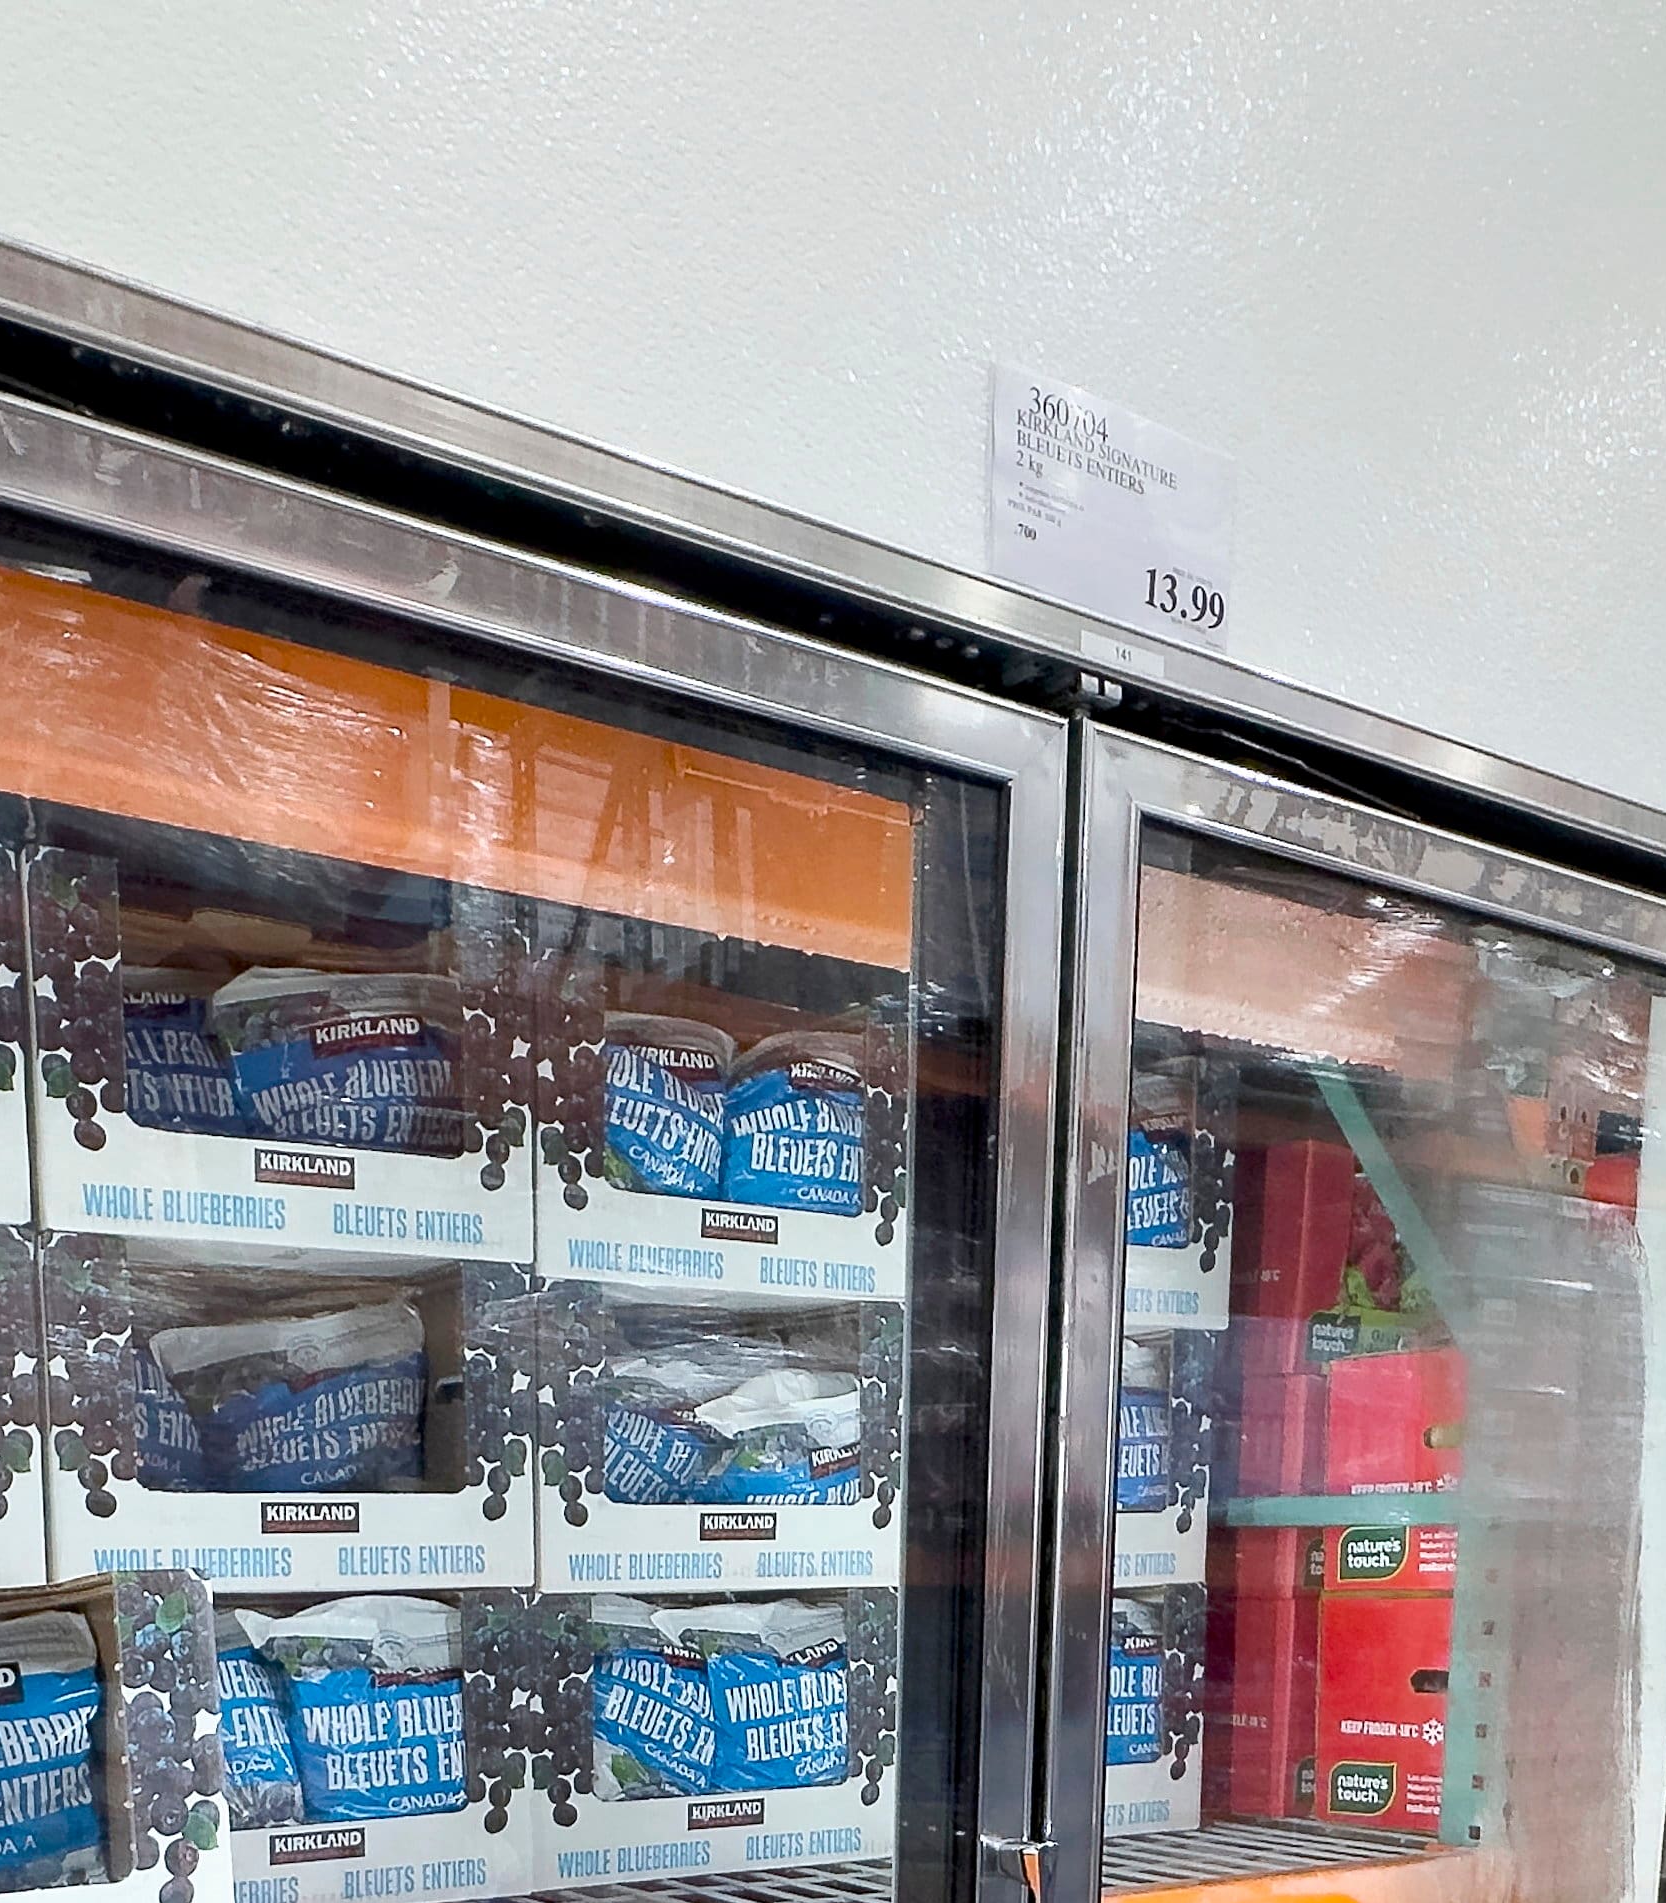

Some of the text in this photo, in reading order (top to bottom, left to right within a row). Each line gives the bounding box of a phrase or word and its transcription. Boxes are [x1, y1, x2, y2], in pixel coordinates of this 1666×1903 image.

[1018, 410, 1178, 490] KIRKLAND SIGNATURE
[1018, 430, 1144, 494] BLEUETS ENTIERS
[1029, 455, 1043, 478] kg
[1145, 569, 1224, 629] 13.99
[1115, 647, 1132, 661] 141
[314, 1017, 421, 1044] KIRKLAND
[633, 1045, 715, 1069] KIRKLAND
[259, 1152, 352, 1176] KIRKLAND
[82, 1183, 484, 1244] WHOLE BLUEBERRIES BLEUETS ENTIERS
[705, 1212, 776, 1232] KIRKLAND
[568, 1239, 875, 1293] WHOLE BLUEBERRIES BLEUETS ENTIERS
[266, 1505, 355, 1523] KIRKLAND
[703, 1514, 774, 1529] KIRKLAND
[1347, 1538, 1401, 1554] nature's
[94, 1545, 485, 1577] WHOLE BLUEBERRIES BLEUETS ENTIERS
[568, 1550, 873, 1581] WHOLE BLUEBERRIES BLEUETS ENTIERS
[1347, 1554, 1389, 1568] touch
[303, 1701, 389, 1745] WHOLE
[327, 1746, 427, 1790] BLEUETS
[1337, 1775, 1388, 1790] nature's
[1337, 1788, 1379, 1803] touch
[692, 1802, 761, 1819] KIRKLAND
[275, 1831, 362, 1853] KIRKLAND
[558, 1827, 862, 1878] WHOLE BLUEBERRIES BLEUETS ENTIERS
[343, 1866, 414, 1898] BLEUETS
[422, 1859, 486, 1890] ENTIERS
